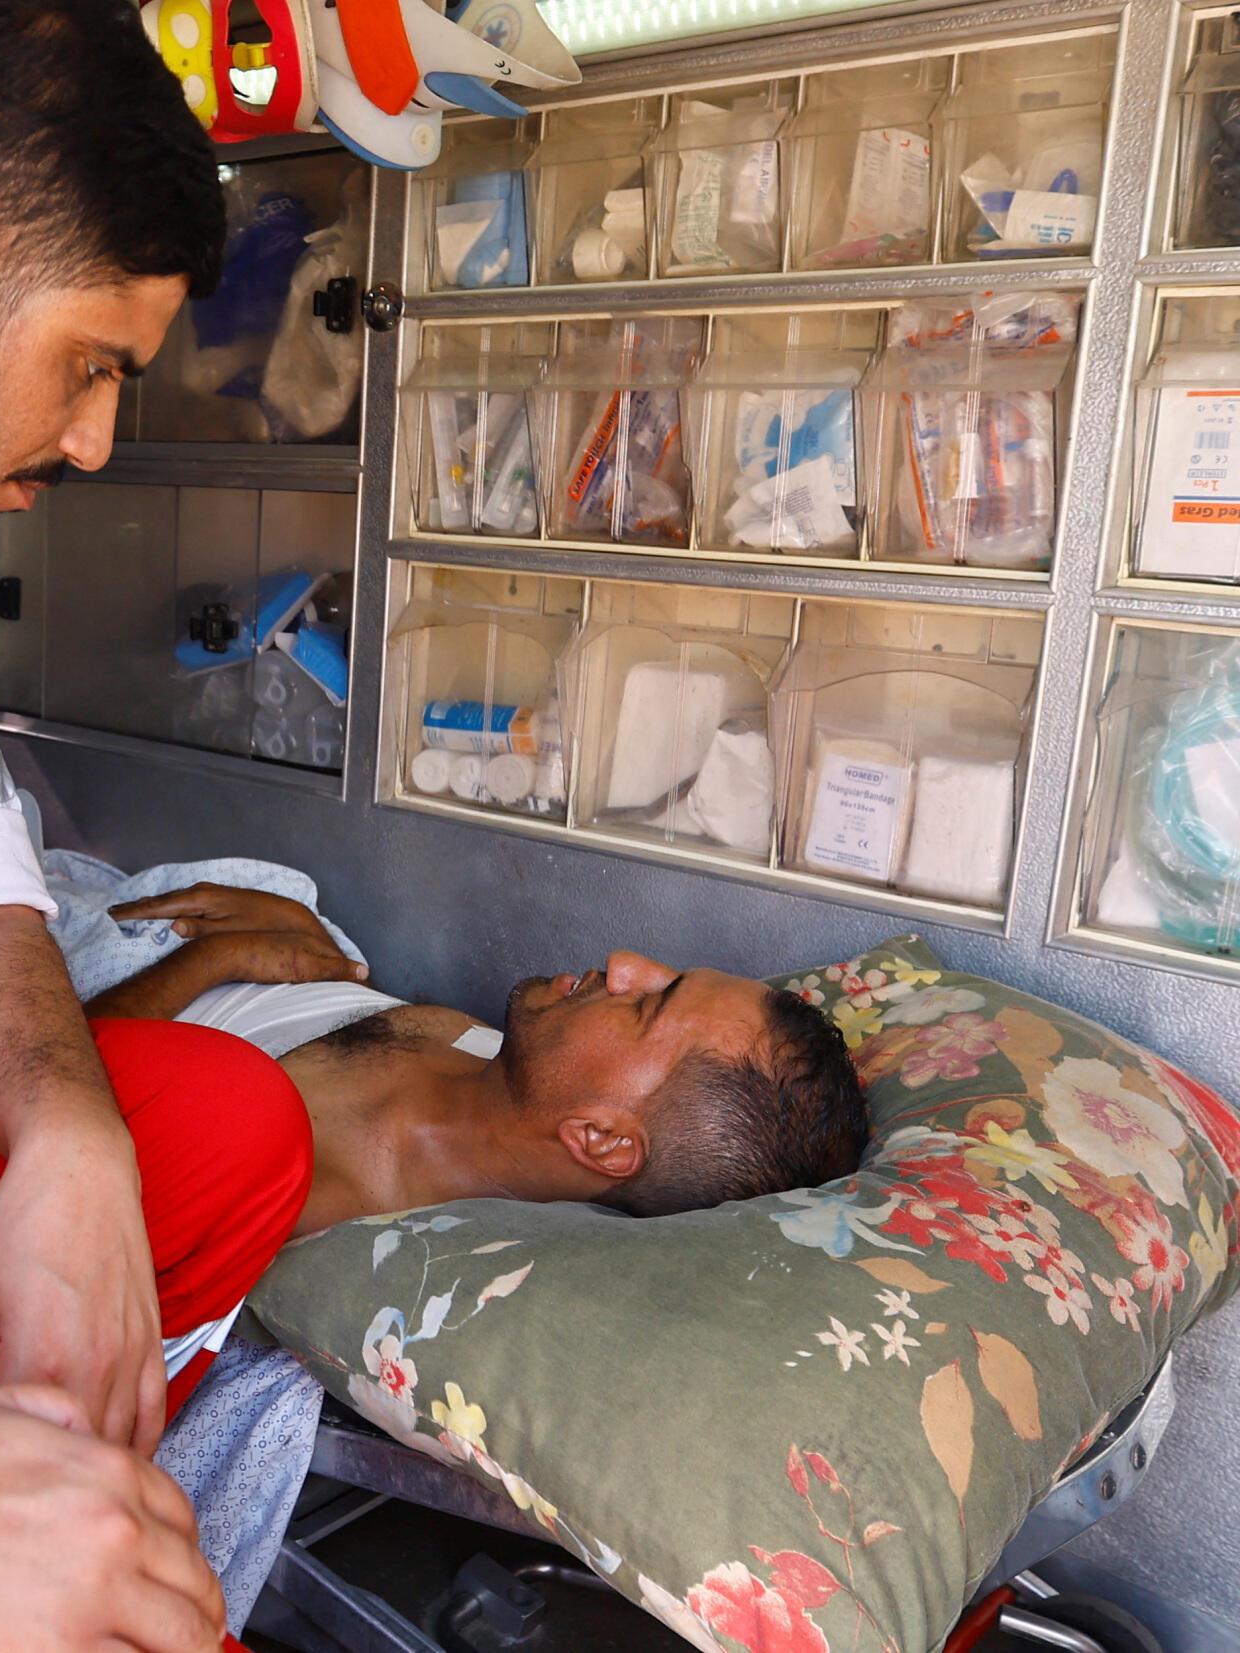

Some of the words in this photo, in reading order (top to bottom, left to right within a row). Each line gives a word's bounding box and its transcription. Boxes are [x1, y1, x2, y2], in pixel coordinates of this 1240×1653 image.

[573, 470, 588, 494] SAFE
[585, 435, 606, 469] TOUCH
[1212, 480, 1219, 491] 1
[1179, 505, 1214, 518] Gras
[826, 782, 862, 797] Triangular
